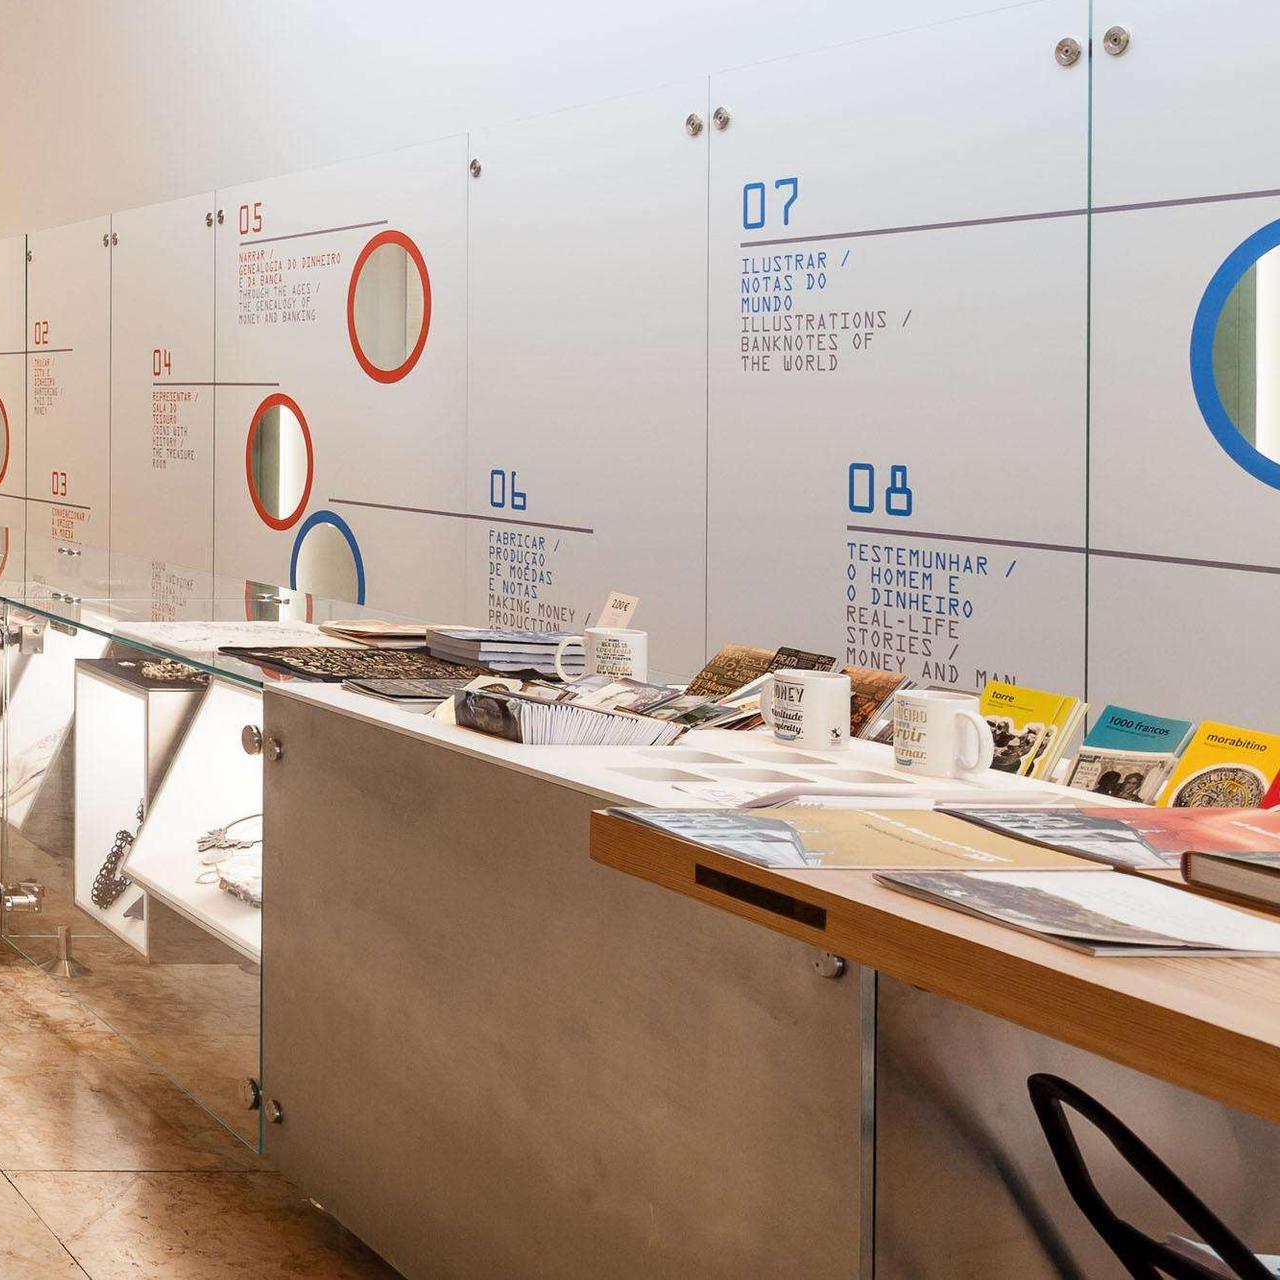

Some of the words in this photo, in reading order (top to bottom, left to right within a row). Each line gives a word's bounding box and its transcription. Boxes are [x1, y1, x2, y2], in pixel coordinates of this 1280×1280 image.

[743, 177, 798, 229] 07
[240, 203, 262, 235] 05
[302, 253, 341, 269] DINHEIRO
[742, 252, 826, 274] ILUSTRAR
[741, 275, 792, 293] NOTAS
[807, 273, 826, 289] DO
[741, 295, 792, 313] MUNDO
[34, 321, 48, 345] 02
[741, 311, 886, 332] ILLUSTRATIONS
[741, 334, 838, 352] BANKNOTES
[853, 332, 873, 350] OF
[153, 349, 171, 376] 04
[741, 356, 770, 371] THE
[784, 355, 838, 371] WORLD
[52, 472, 66, 496] 03
[491, 470, 526, 510] 06
[849, 463, 912, 516] 08
[490, 530, 545, 550] FABRICAR
[489, 546, 545, 568] PRODUÇÃO
[847, 542, 987, 575] TESTEMUNHAR
[489, 562, 501, 576] DE
[847, 564, 856, 580] O
[871, 567, 932, 591] HOMEM
[949, 576, 959, 594] E
[489, 578, 494, 591] E
[503, 581, 537, 599] NOTAS
[489, 593, 529, 614] MAKING
[539, 602, 575, 623] MONEY
[847, 585, 856, 602] O
[872, 588, 973, 618] DINHEIRO
[847, 605, 959, 639] REAL-LIFE
[847, 626, 932, 657] STORIES
[847, 647, 905, 673] MONEY
[922, 661, 959, 683] AND
[992, 691, 1014, 702] torre
[1109, 716, 1134, 729] 1000
[1134, 722, 1170, 736] francos
[1207, 733, 1267, 752] morabitino
